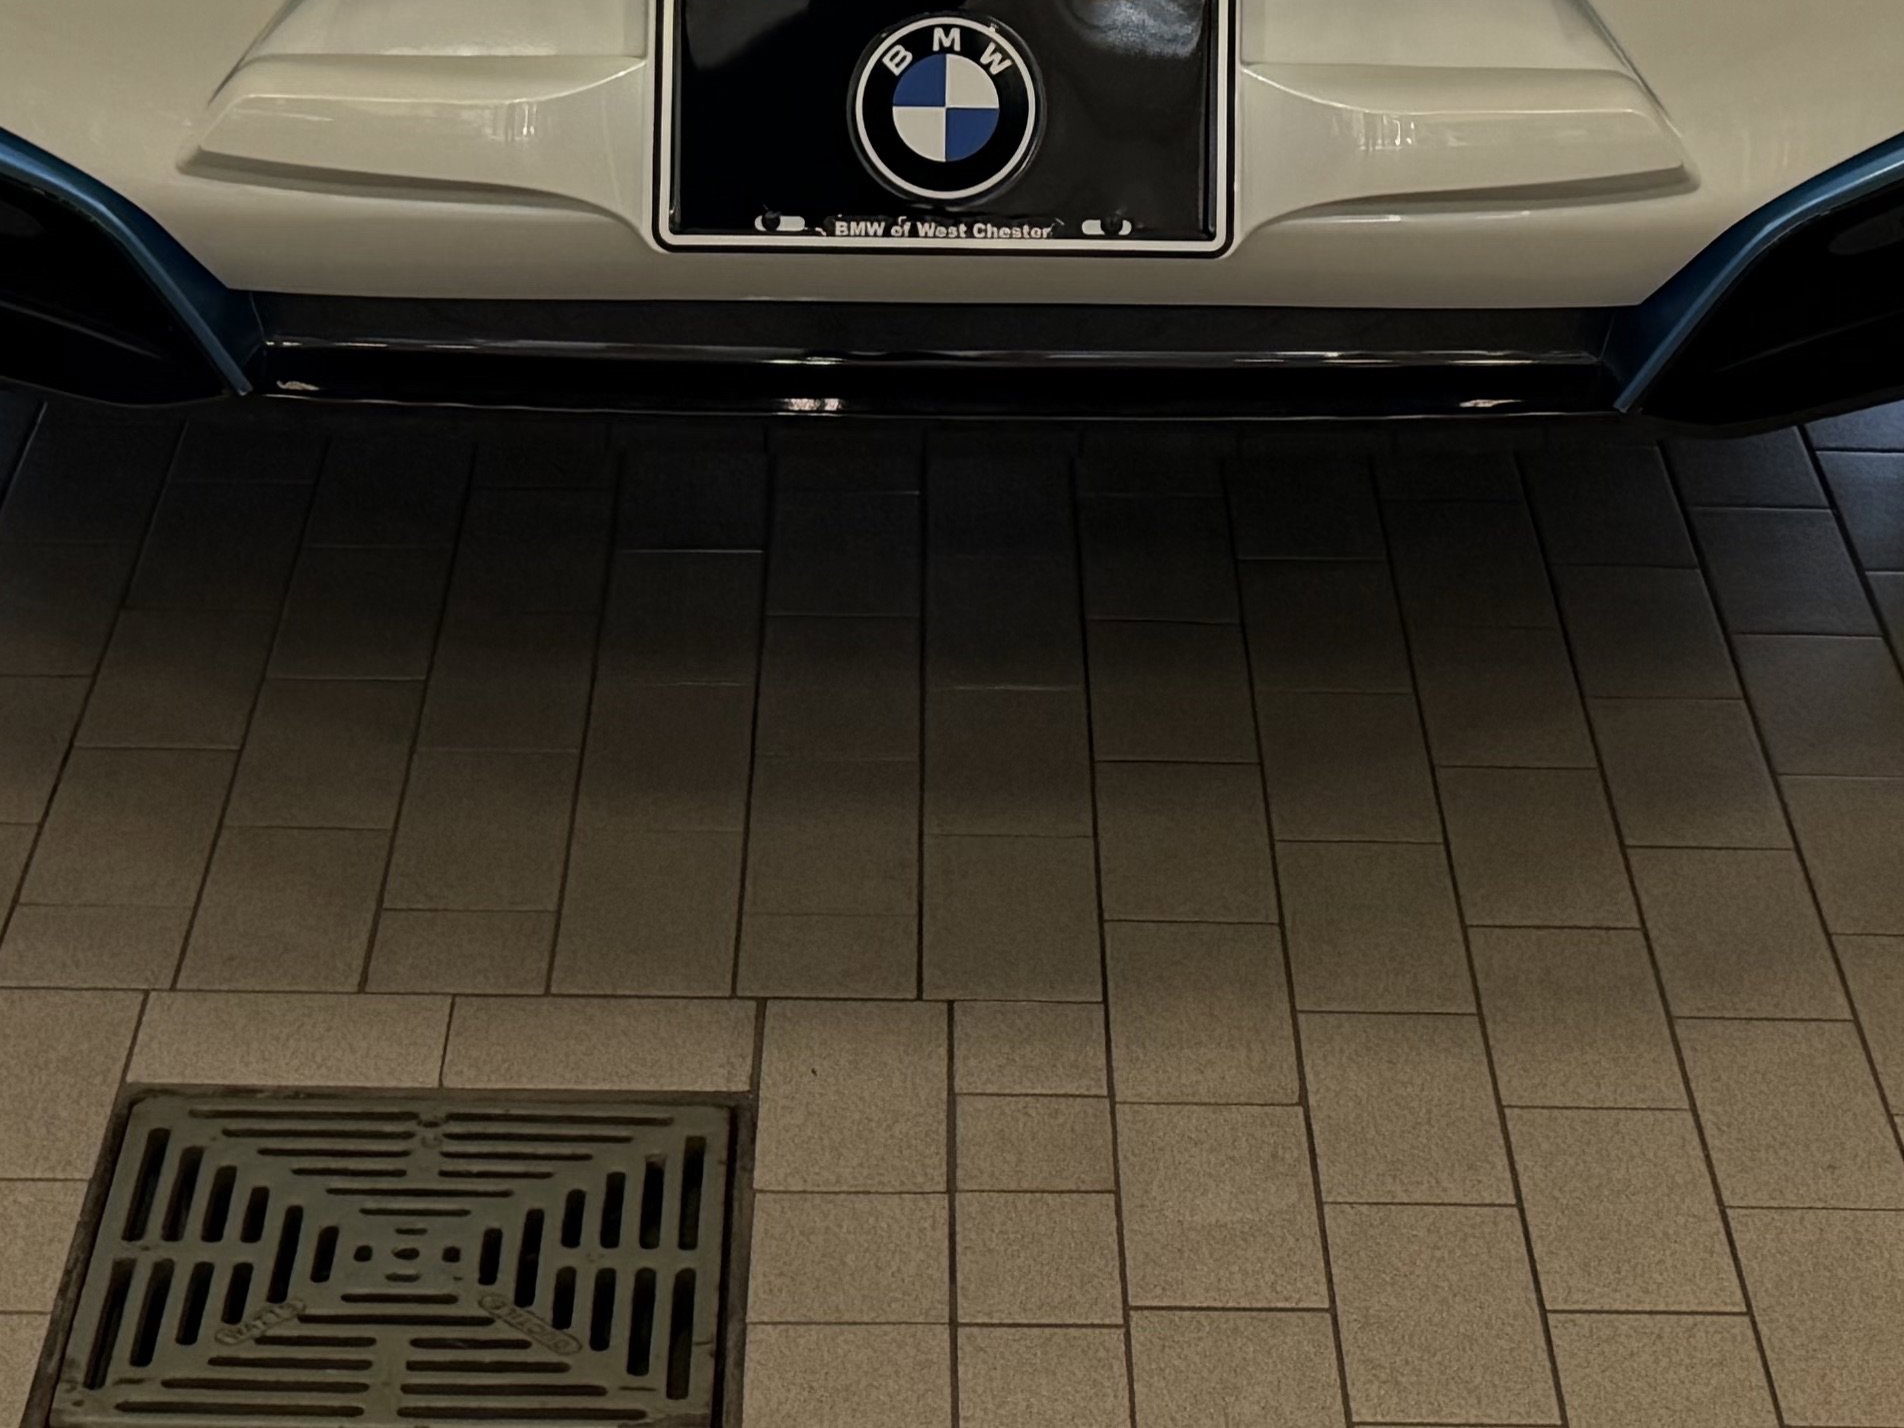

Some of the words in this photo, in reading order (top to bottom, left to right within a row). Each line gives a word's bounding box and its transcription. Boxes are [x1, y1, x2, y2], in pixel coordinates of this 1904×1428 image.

[881, 27, 1013, 77] BMW
[834, 220, 886, 237] BMW
[891, 221, 911, 237] of
[917, 222, 967, 238] West
[972, 222, 1051, 239] Chester
